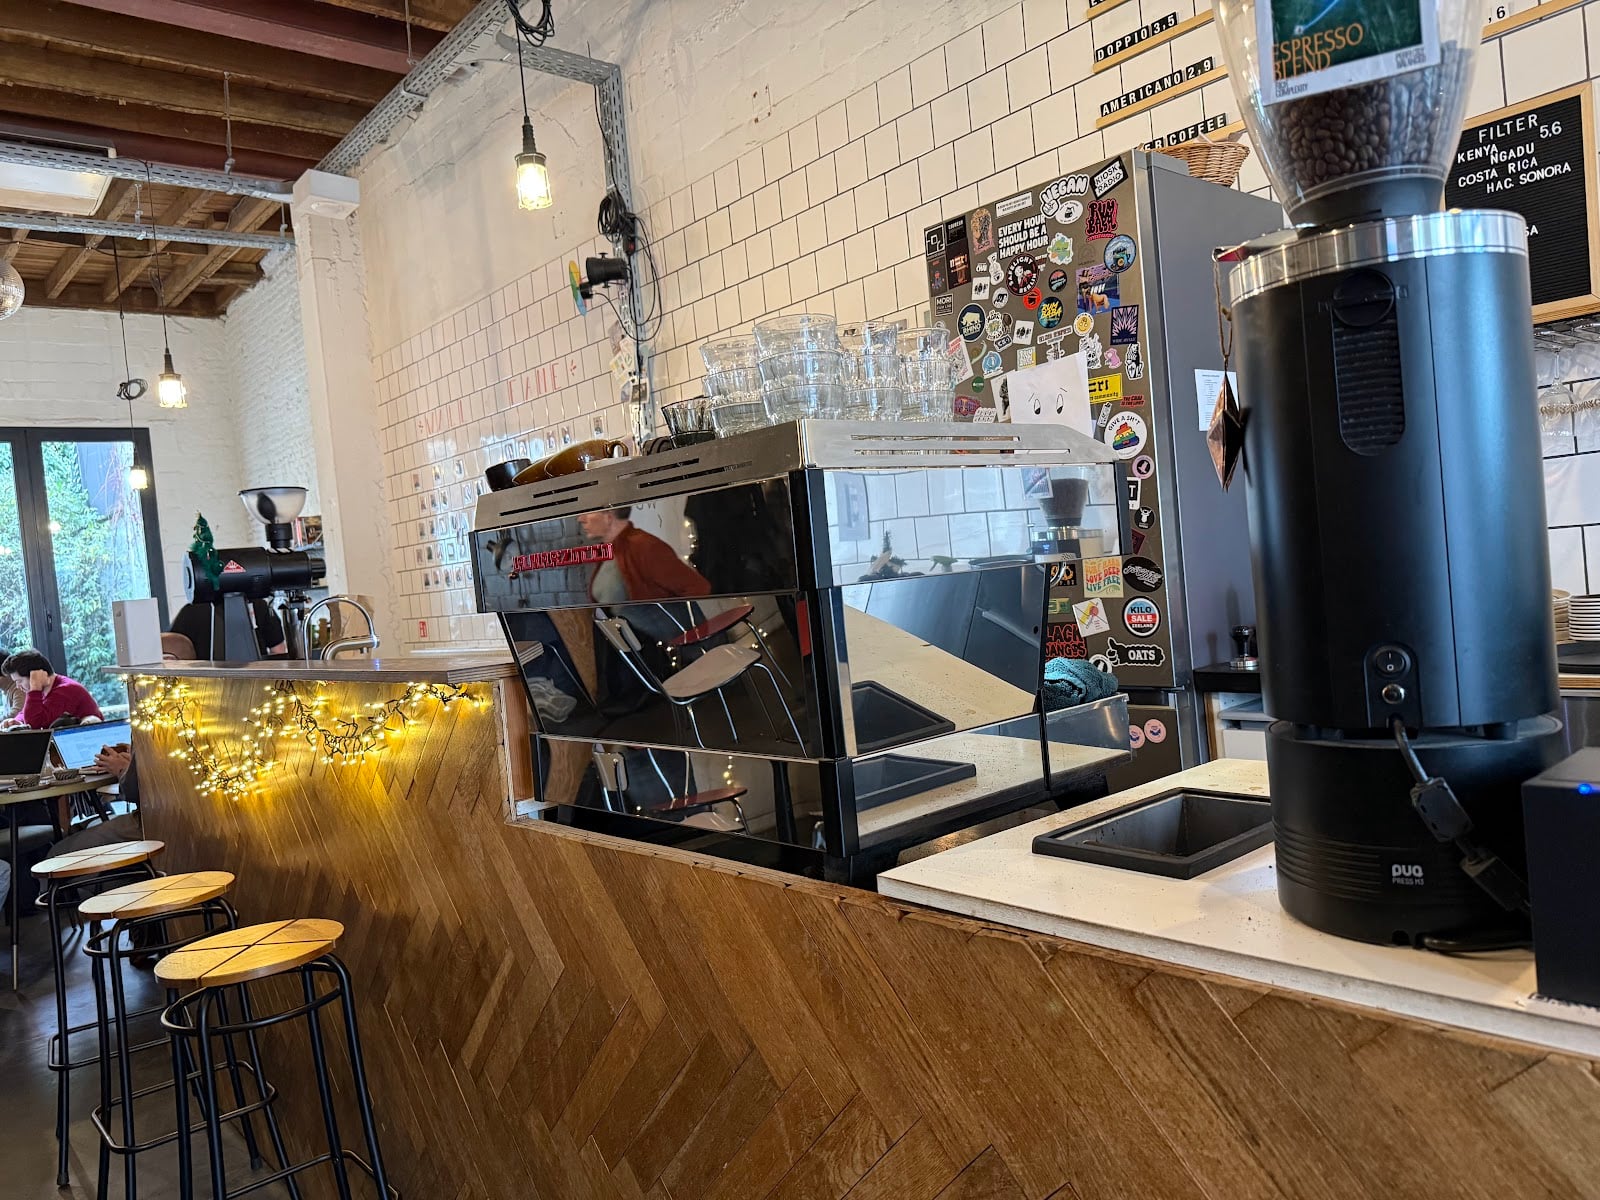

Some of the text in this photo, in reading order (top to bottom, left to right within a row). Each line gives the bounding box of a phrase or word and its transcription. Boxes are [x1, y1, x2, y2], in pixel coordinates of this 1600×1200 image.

[1097, 15, 1176, 61] DOPPIO 3,5
[1102, 60, 1212, 116] AMERICANO 2,9
[1169, 114, 1226, 146] COFFEE
[1478, 114, 1539, 143] FILTER
[1457, 144, 1499, 164] KENYA
[1490, 142, 1535, 165] NGADU
[1095, 165, 1118, 185] KIOSK
[1098, 172, 1122, 193] RADIO
[1458, 157, 1538, 188] COSTA RICA
[1519, 162, 1572, 185] SONORA
[1041, 175, 1088, 204] VEGAN
[998, 221, 1023, 238] EVERY
[1023, 214, 1046, 230] HOUR
[998, 224, 1047, 249] SHOULD BE A
[999, 234, 1049, 260] HAPPY HOUR
[963, 324, 981, 336] RHINO
[1108, 417, 1120, 431] GIVE
[1086, 572, 1103, 584] LOVE
[1103, 566, 1120, 578] DEEP
[1086, 582, 1102, 592] LIVE
[1103, 575, 1120, 587] FREE
[1130, 606, 1152, 614] KILO
[1131, 614, 1153, 623] SALE
[1128, 650, 1156, 660] OATS
